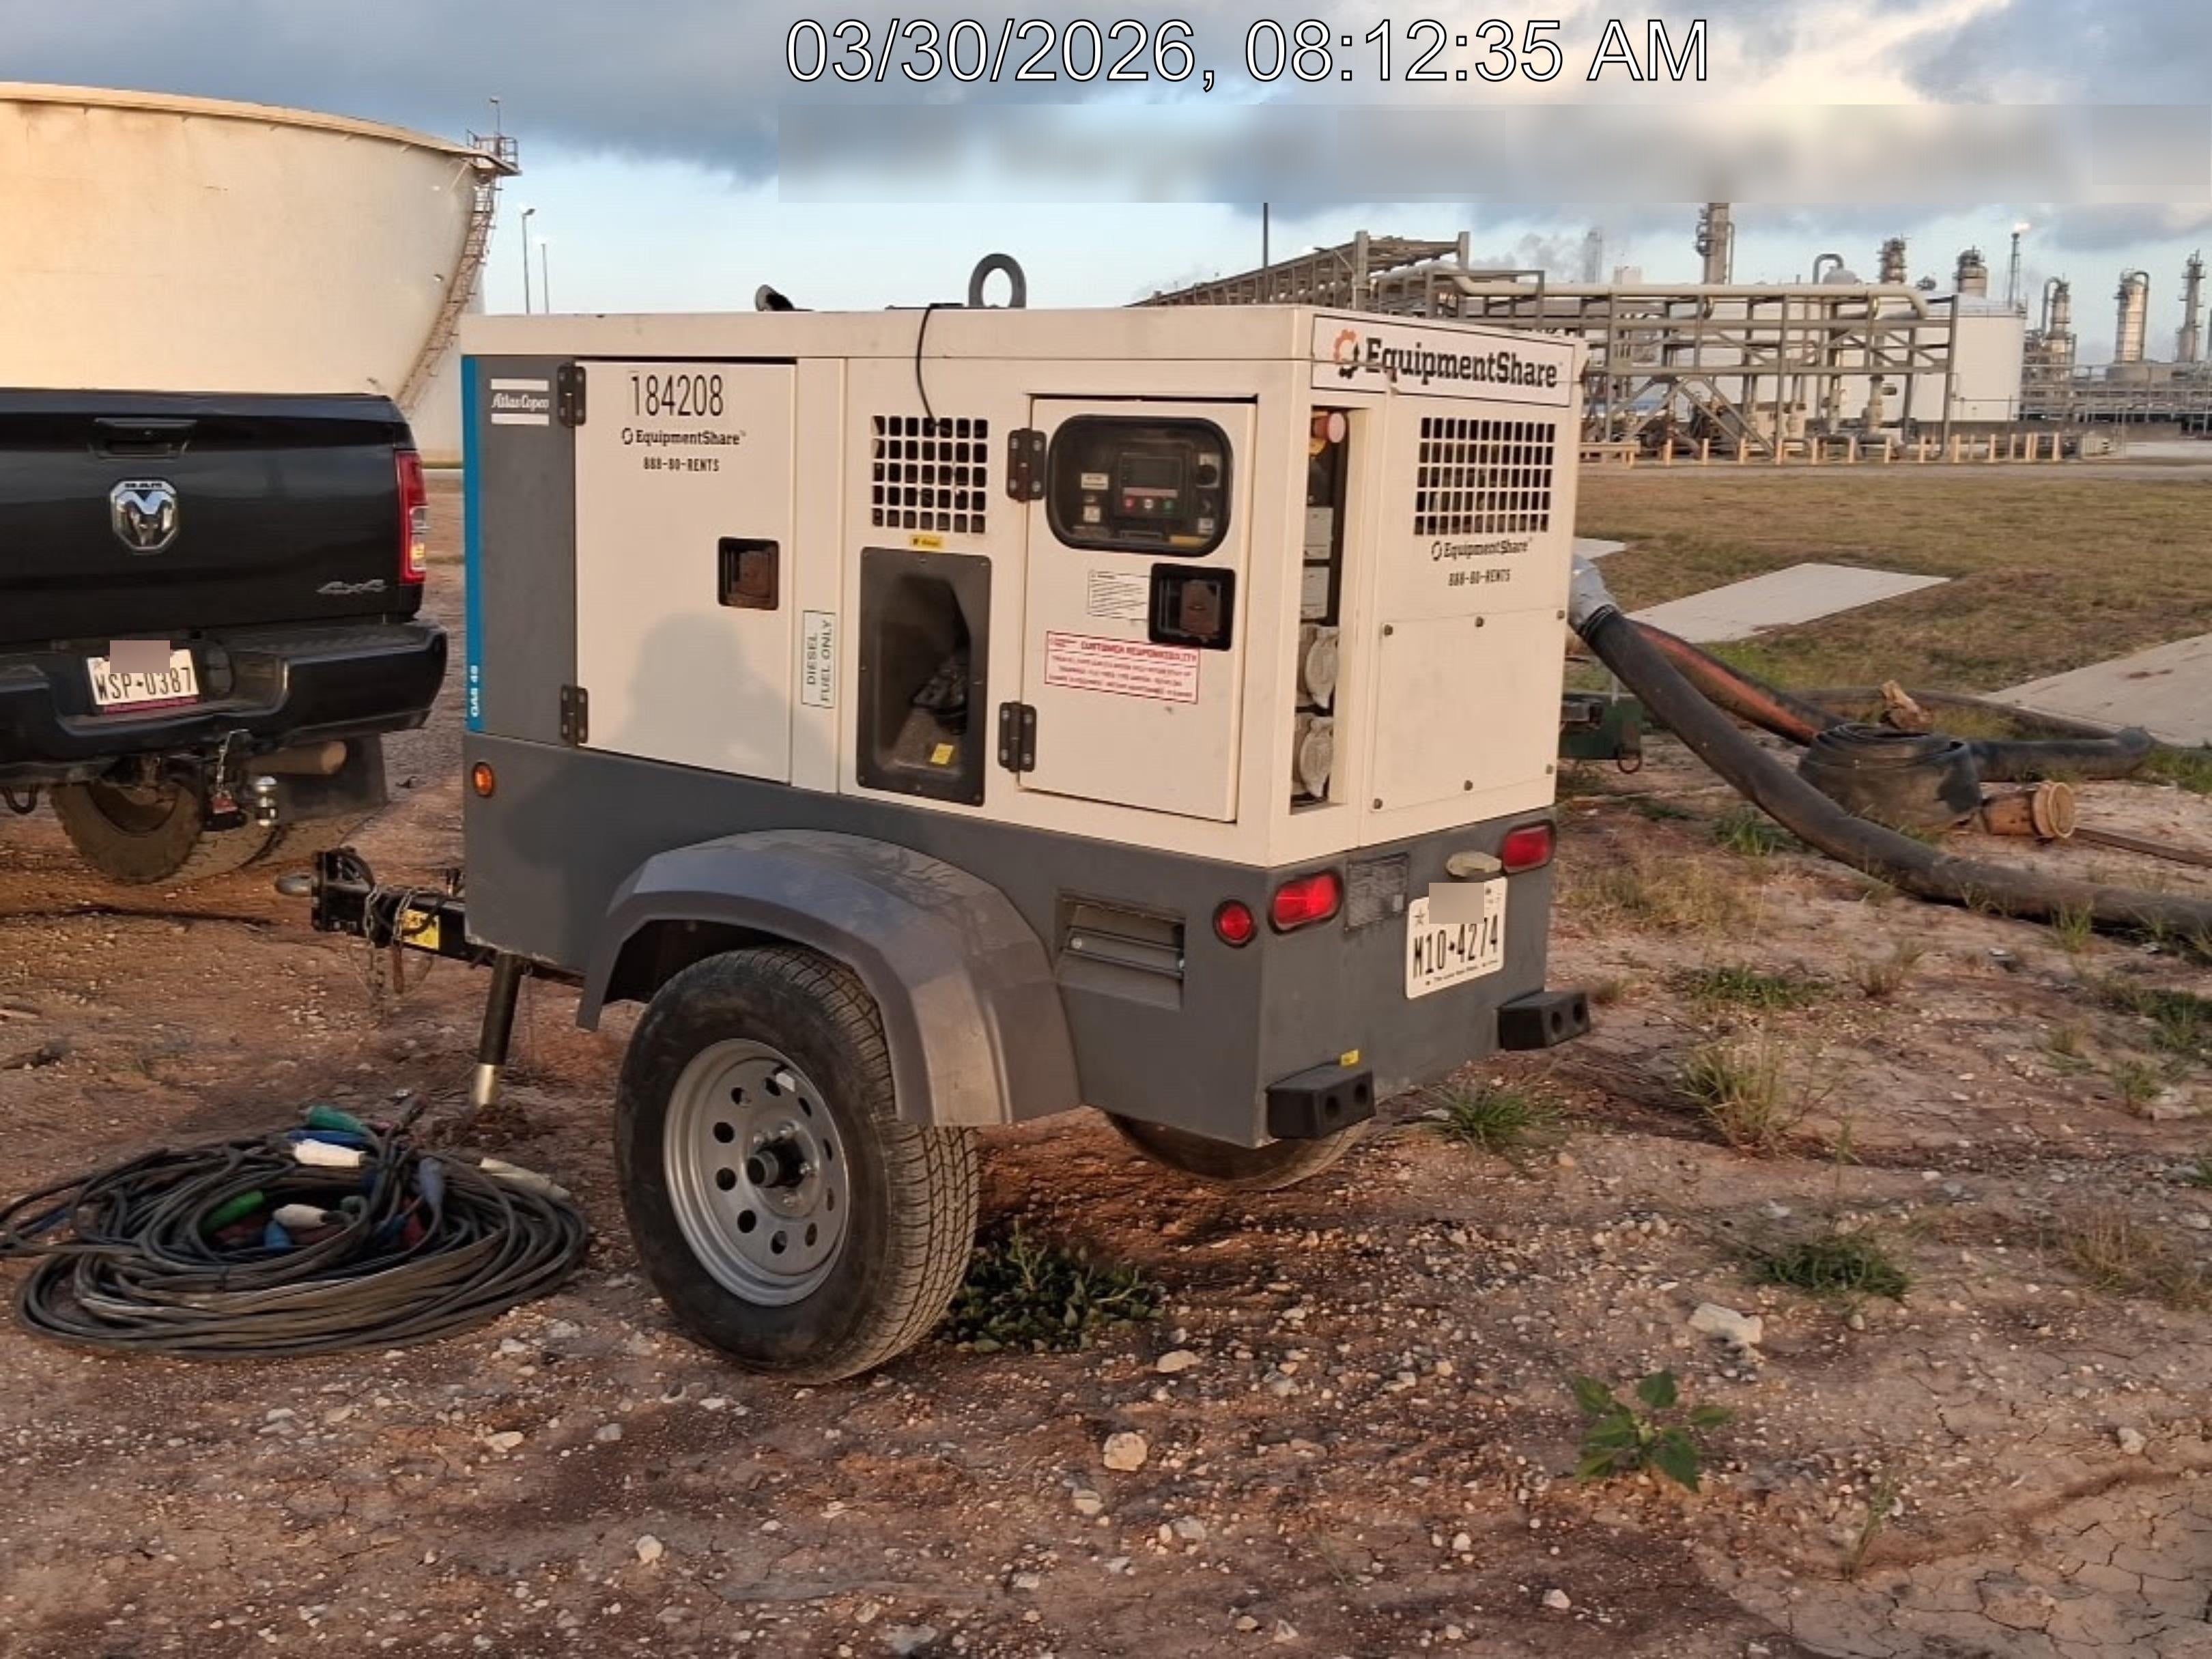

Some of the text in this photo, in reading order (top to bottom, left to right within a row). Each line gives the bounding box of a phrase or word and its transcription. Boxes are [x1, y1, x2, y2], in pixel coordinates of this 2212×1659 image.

[1365, 338, 1558, 388] EquipmentShare
[630, 374, 724, 416] 184208
[635, 429, 741, 447] EquipmentShare
[1443, 539, 1529, 561] EquipmentShare
[806, 633, 818, 685] DIESEL
[821, 619, 832, 702] FUEL ONLY
